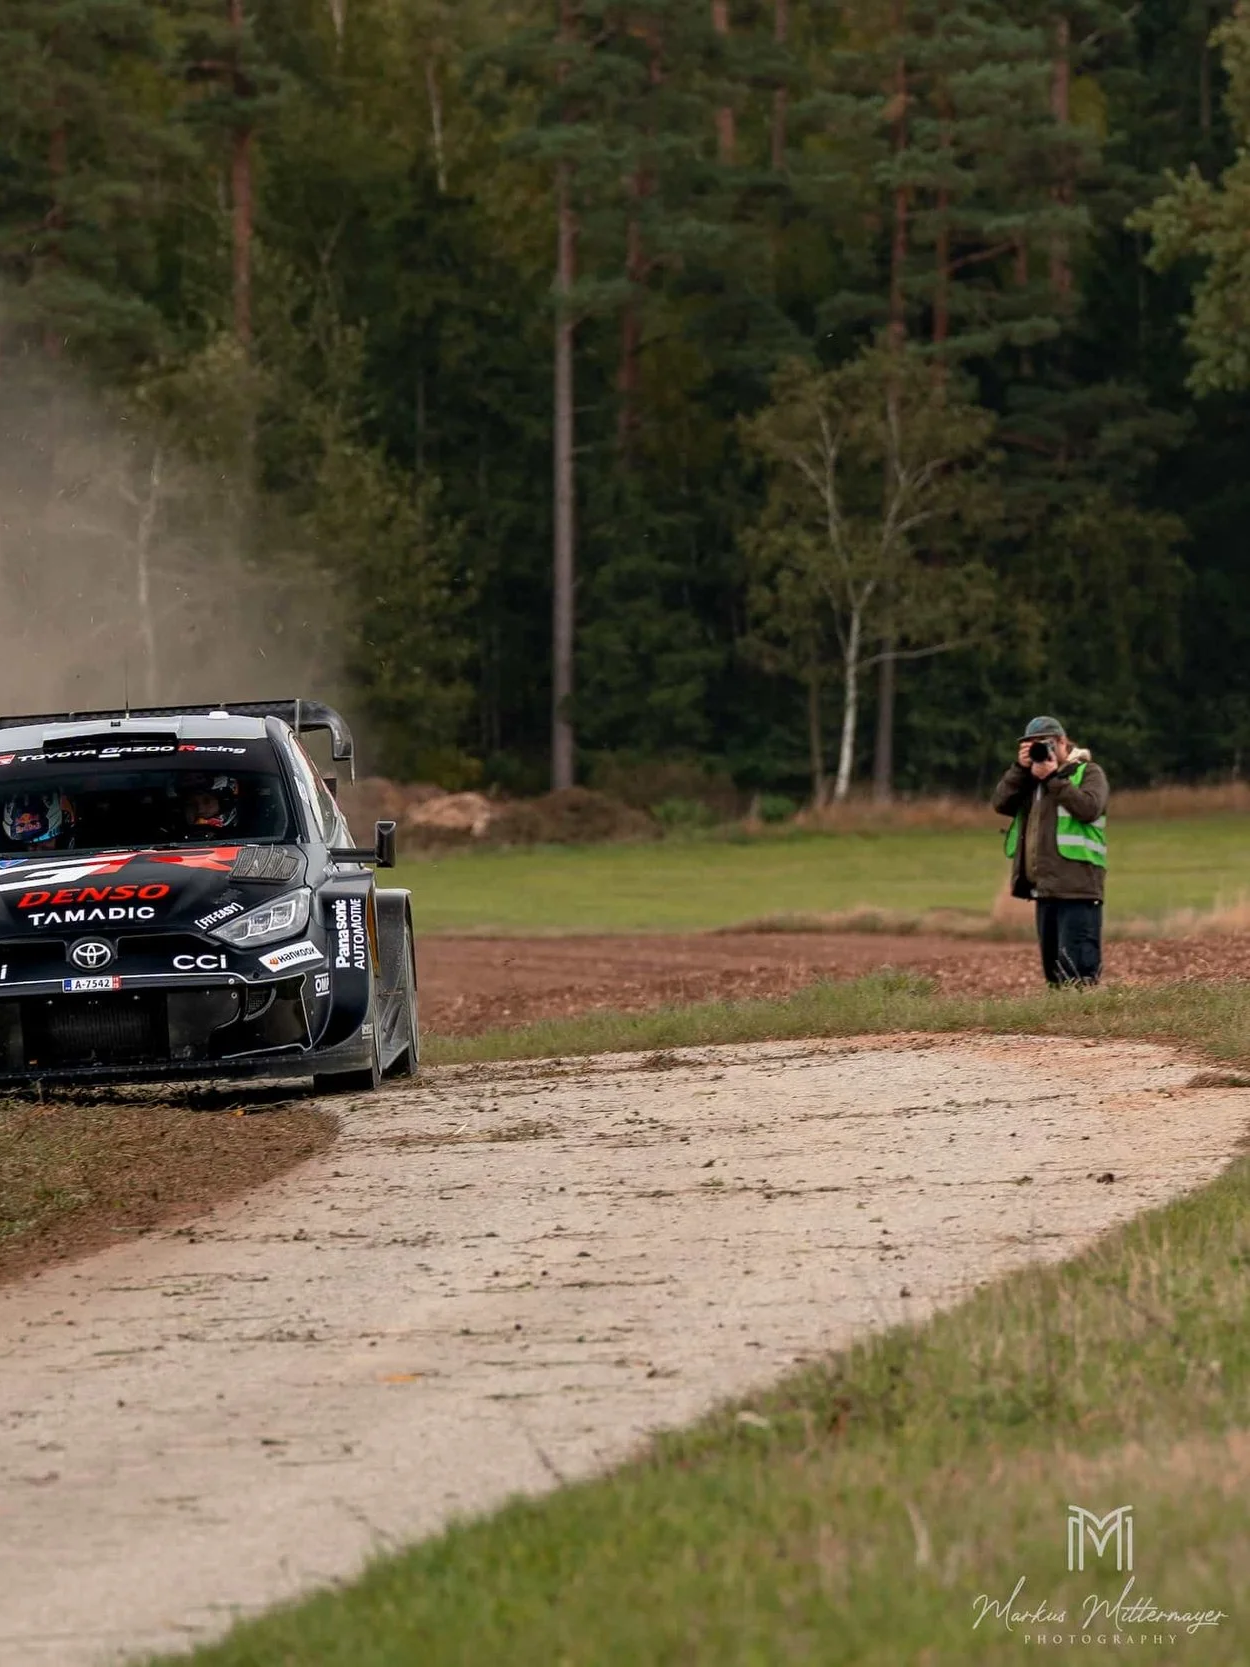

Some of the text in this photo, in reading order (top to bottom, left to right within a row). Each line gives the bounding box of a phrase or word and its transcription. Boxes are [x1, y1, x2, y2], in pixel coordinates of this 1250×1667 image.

[17, 750, 97, 762] TOYOTA
[100, 745, 176, 755] GAZOO
[178, 744, 247, 755] Racing
[17, 883, 171, 909] DENSO
[28, 905, 156, 926] TAMADIC
[332, 899, 350, 968] Panasonic
[350, 898, 366, 970] AUTOMOTIVE
[74, 978, 111, 989] A-7542
